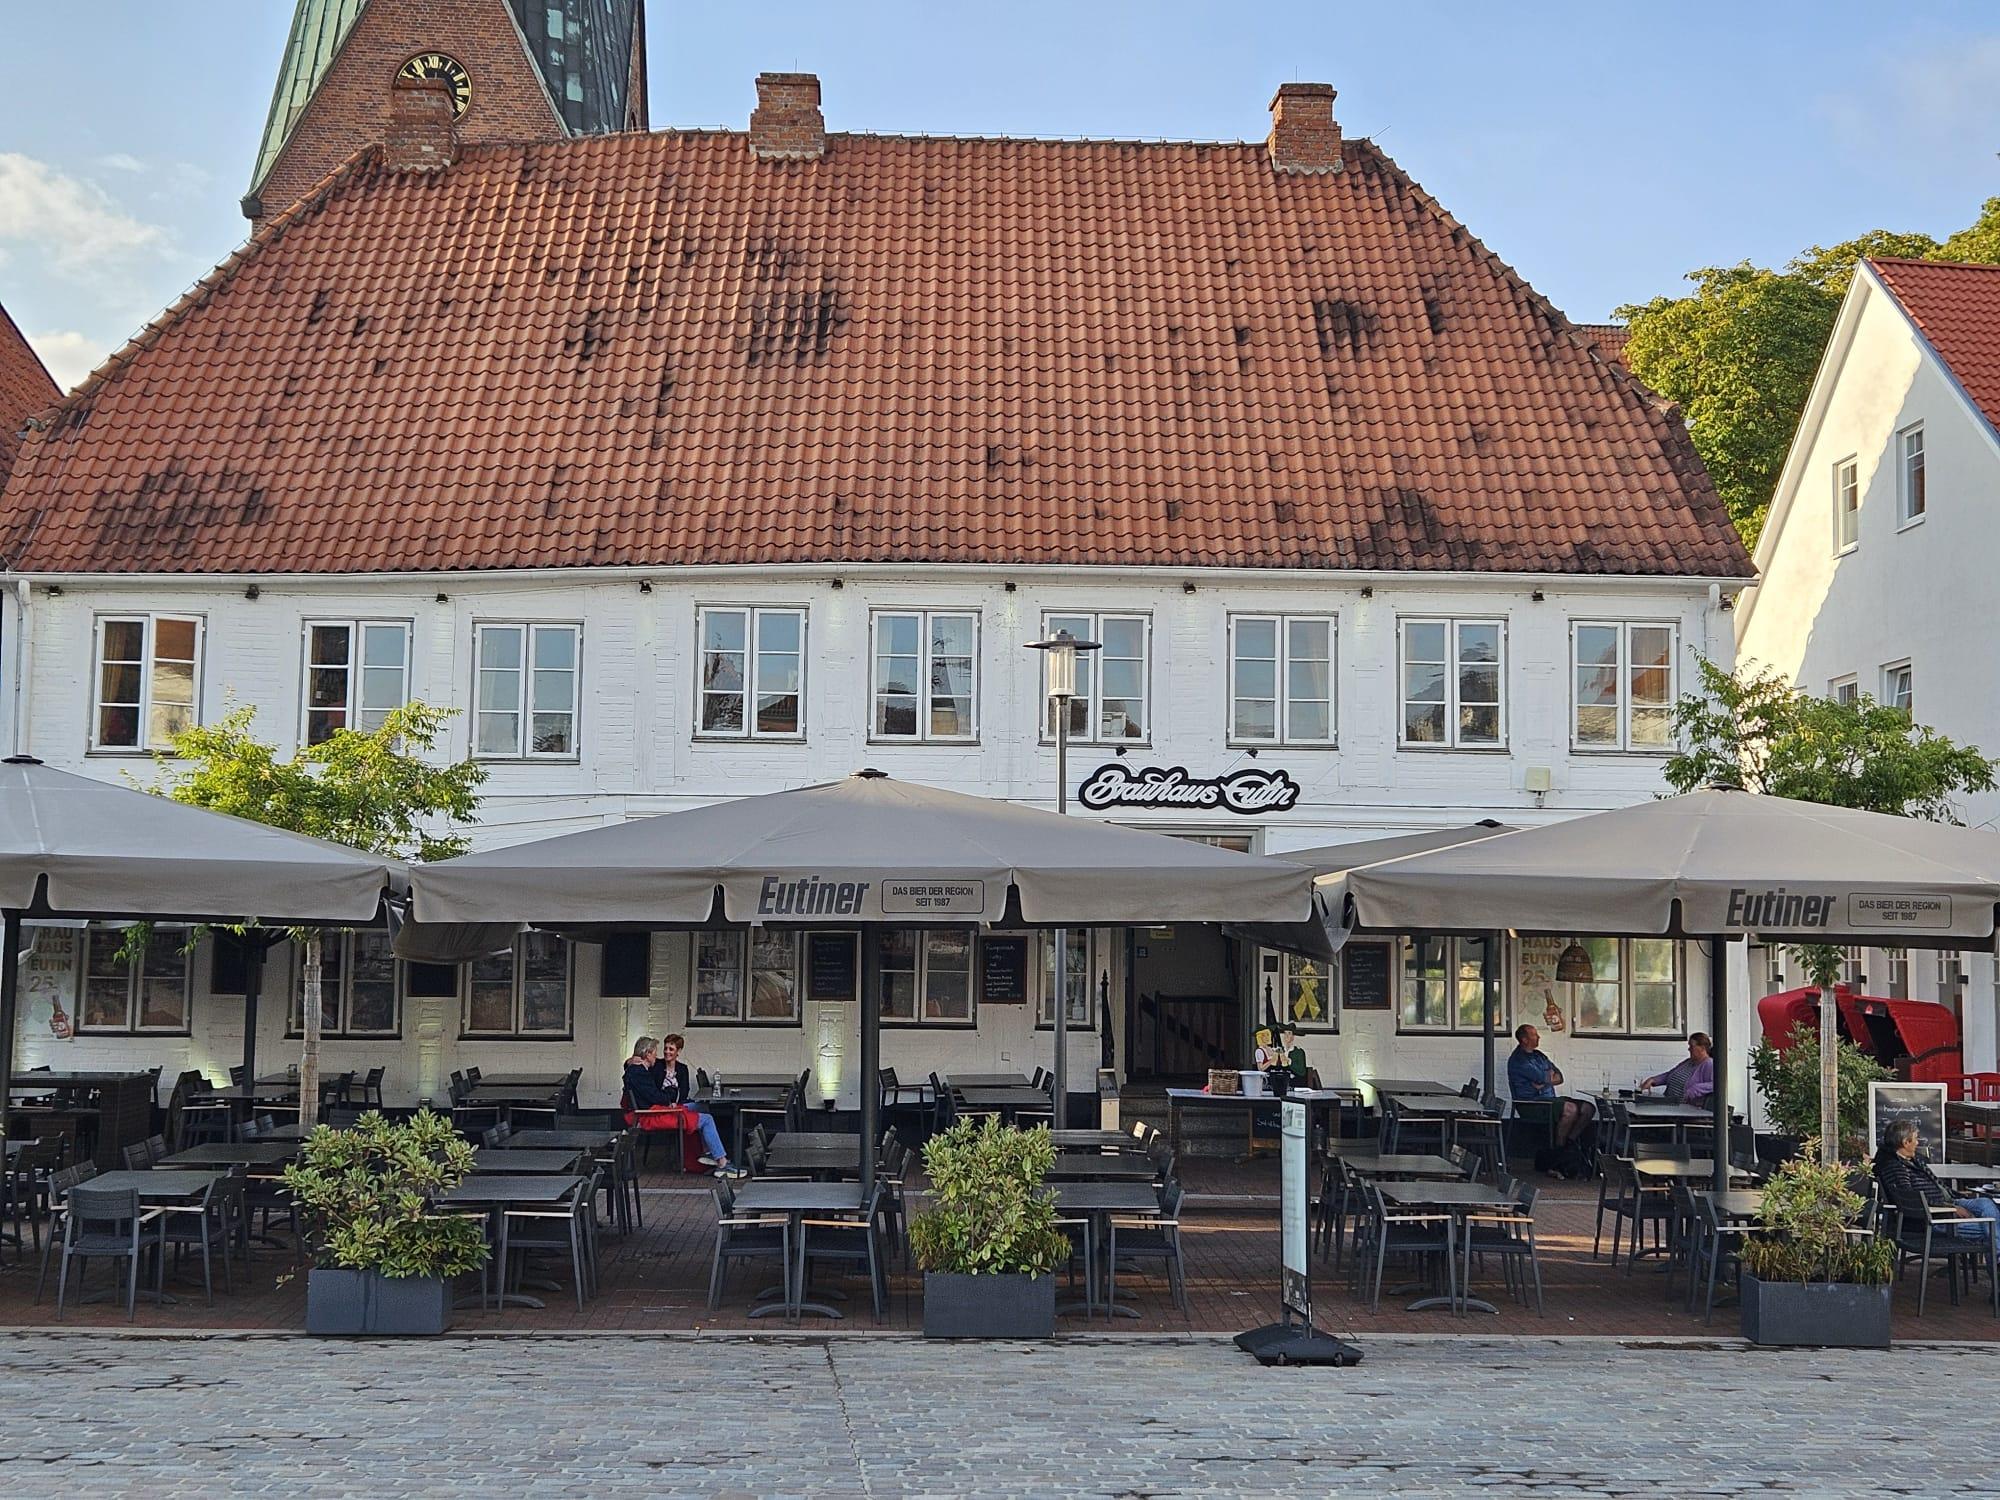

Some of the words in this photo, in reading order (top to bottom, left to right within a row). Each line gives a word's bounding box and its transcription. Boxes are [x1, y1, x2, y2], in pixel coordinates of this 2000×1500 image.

[1084, 769, 1219, 805] Brauhaus
[1220, 775, 1295, 809] Eutin
[757, 875, 870, 915] Eutiner
[892, 886, 908, 896] DAS
[910, 886, 927, 896] BIER
[928, 886, 944, 896] DER
[945, 886, 974, 896] REGION
[915, 897, 932, 907] SEIT
[934, 897, 951, 907] 1987
[1725, 887, 1836, 927] Eutiner
[1859, 900, 1875, 910] DAS
[1876, 900, 1893, 910] BIER
[1895, 901, 1911, 910] DER
[1912, 901, 1942, 911] REGION
[1882, 911, 1899, 921] SEIT
[30, 958, 72, 972] EUTIN
